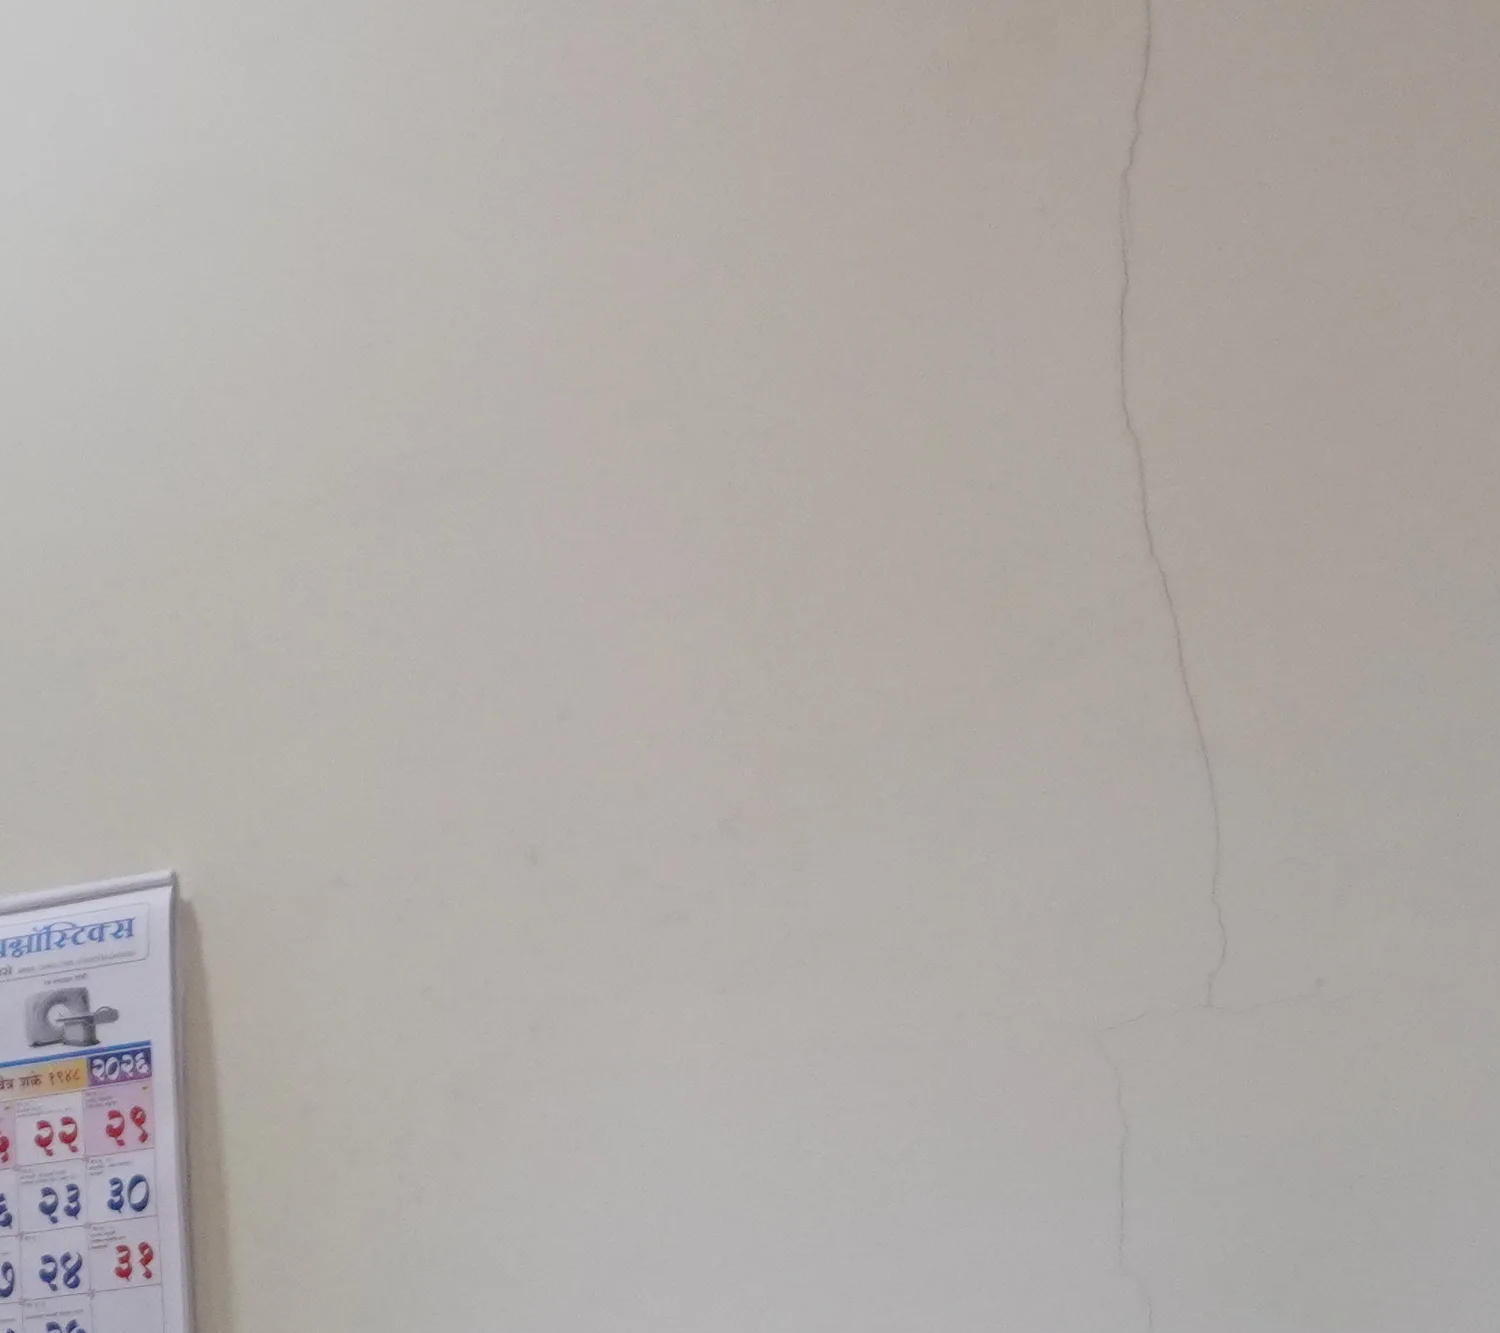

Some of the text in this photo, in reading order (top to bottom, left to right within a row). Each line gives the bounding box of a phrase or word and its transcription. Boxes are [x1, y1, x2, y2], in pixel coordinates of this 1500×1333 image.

[91, 1053, 151, 1082] २०२६
[34, 1116, 79, 1157] २२
[105, 1105, 147, 1147] २९
[38, 1183, 82, 1224] २३
[106, 1173, 150, 1213] ३०
[38, 1251, 83, 1291] २४
[114, 1241, 154, 1281] ३१
